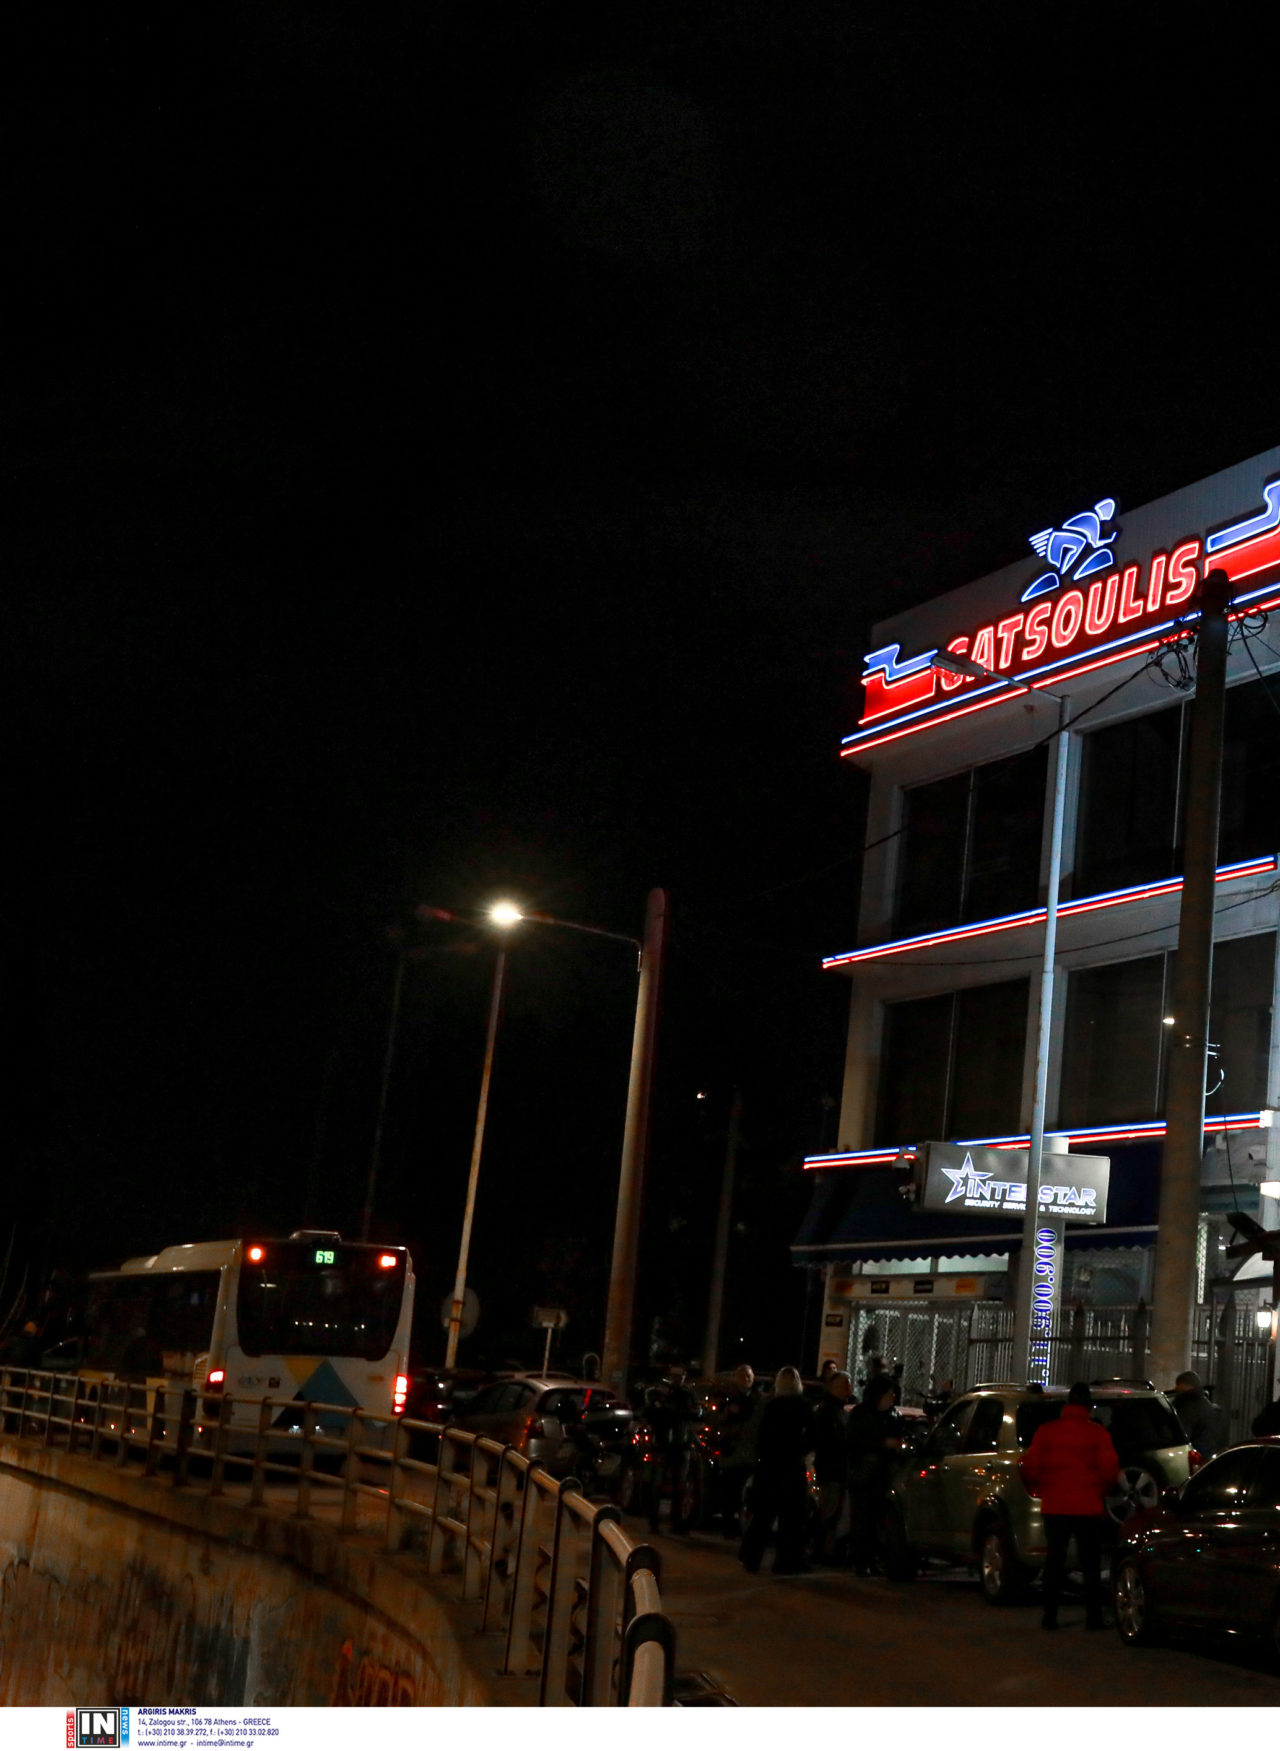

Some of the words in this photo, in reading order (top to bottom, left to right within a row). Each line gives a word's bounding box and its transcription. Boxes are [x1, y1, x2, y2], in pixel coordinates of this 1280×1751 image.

[966, 1178, 1097, 1207] INTESTAR
[964, 1199, 1001, 1208] SECURITY
[1048, 1205, 1097, 1216] TECHNOLOGY
[315, 1251, 335, 1264] 619
